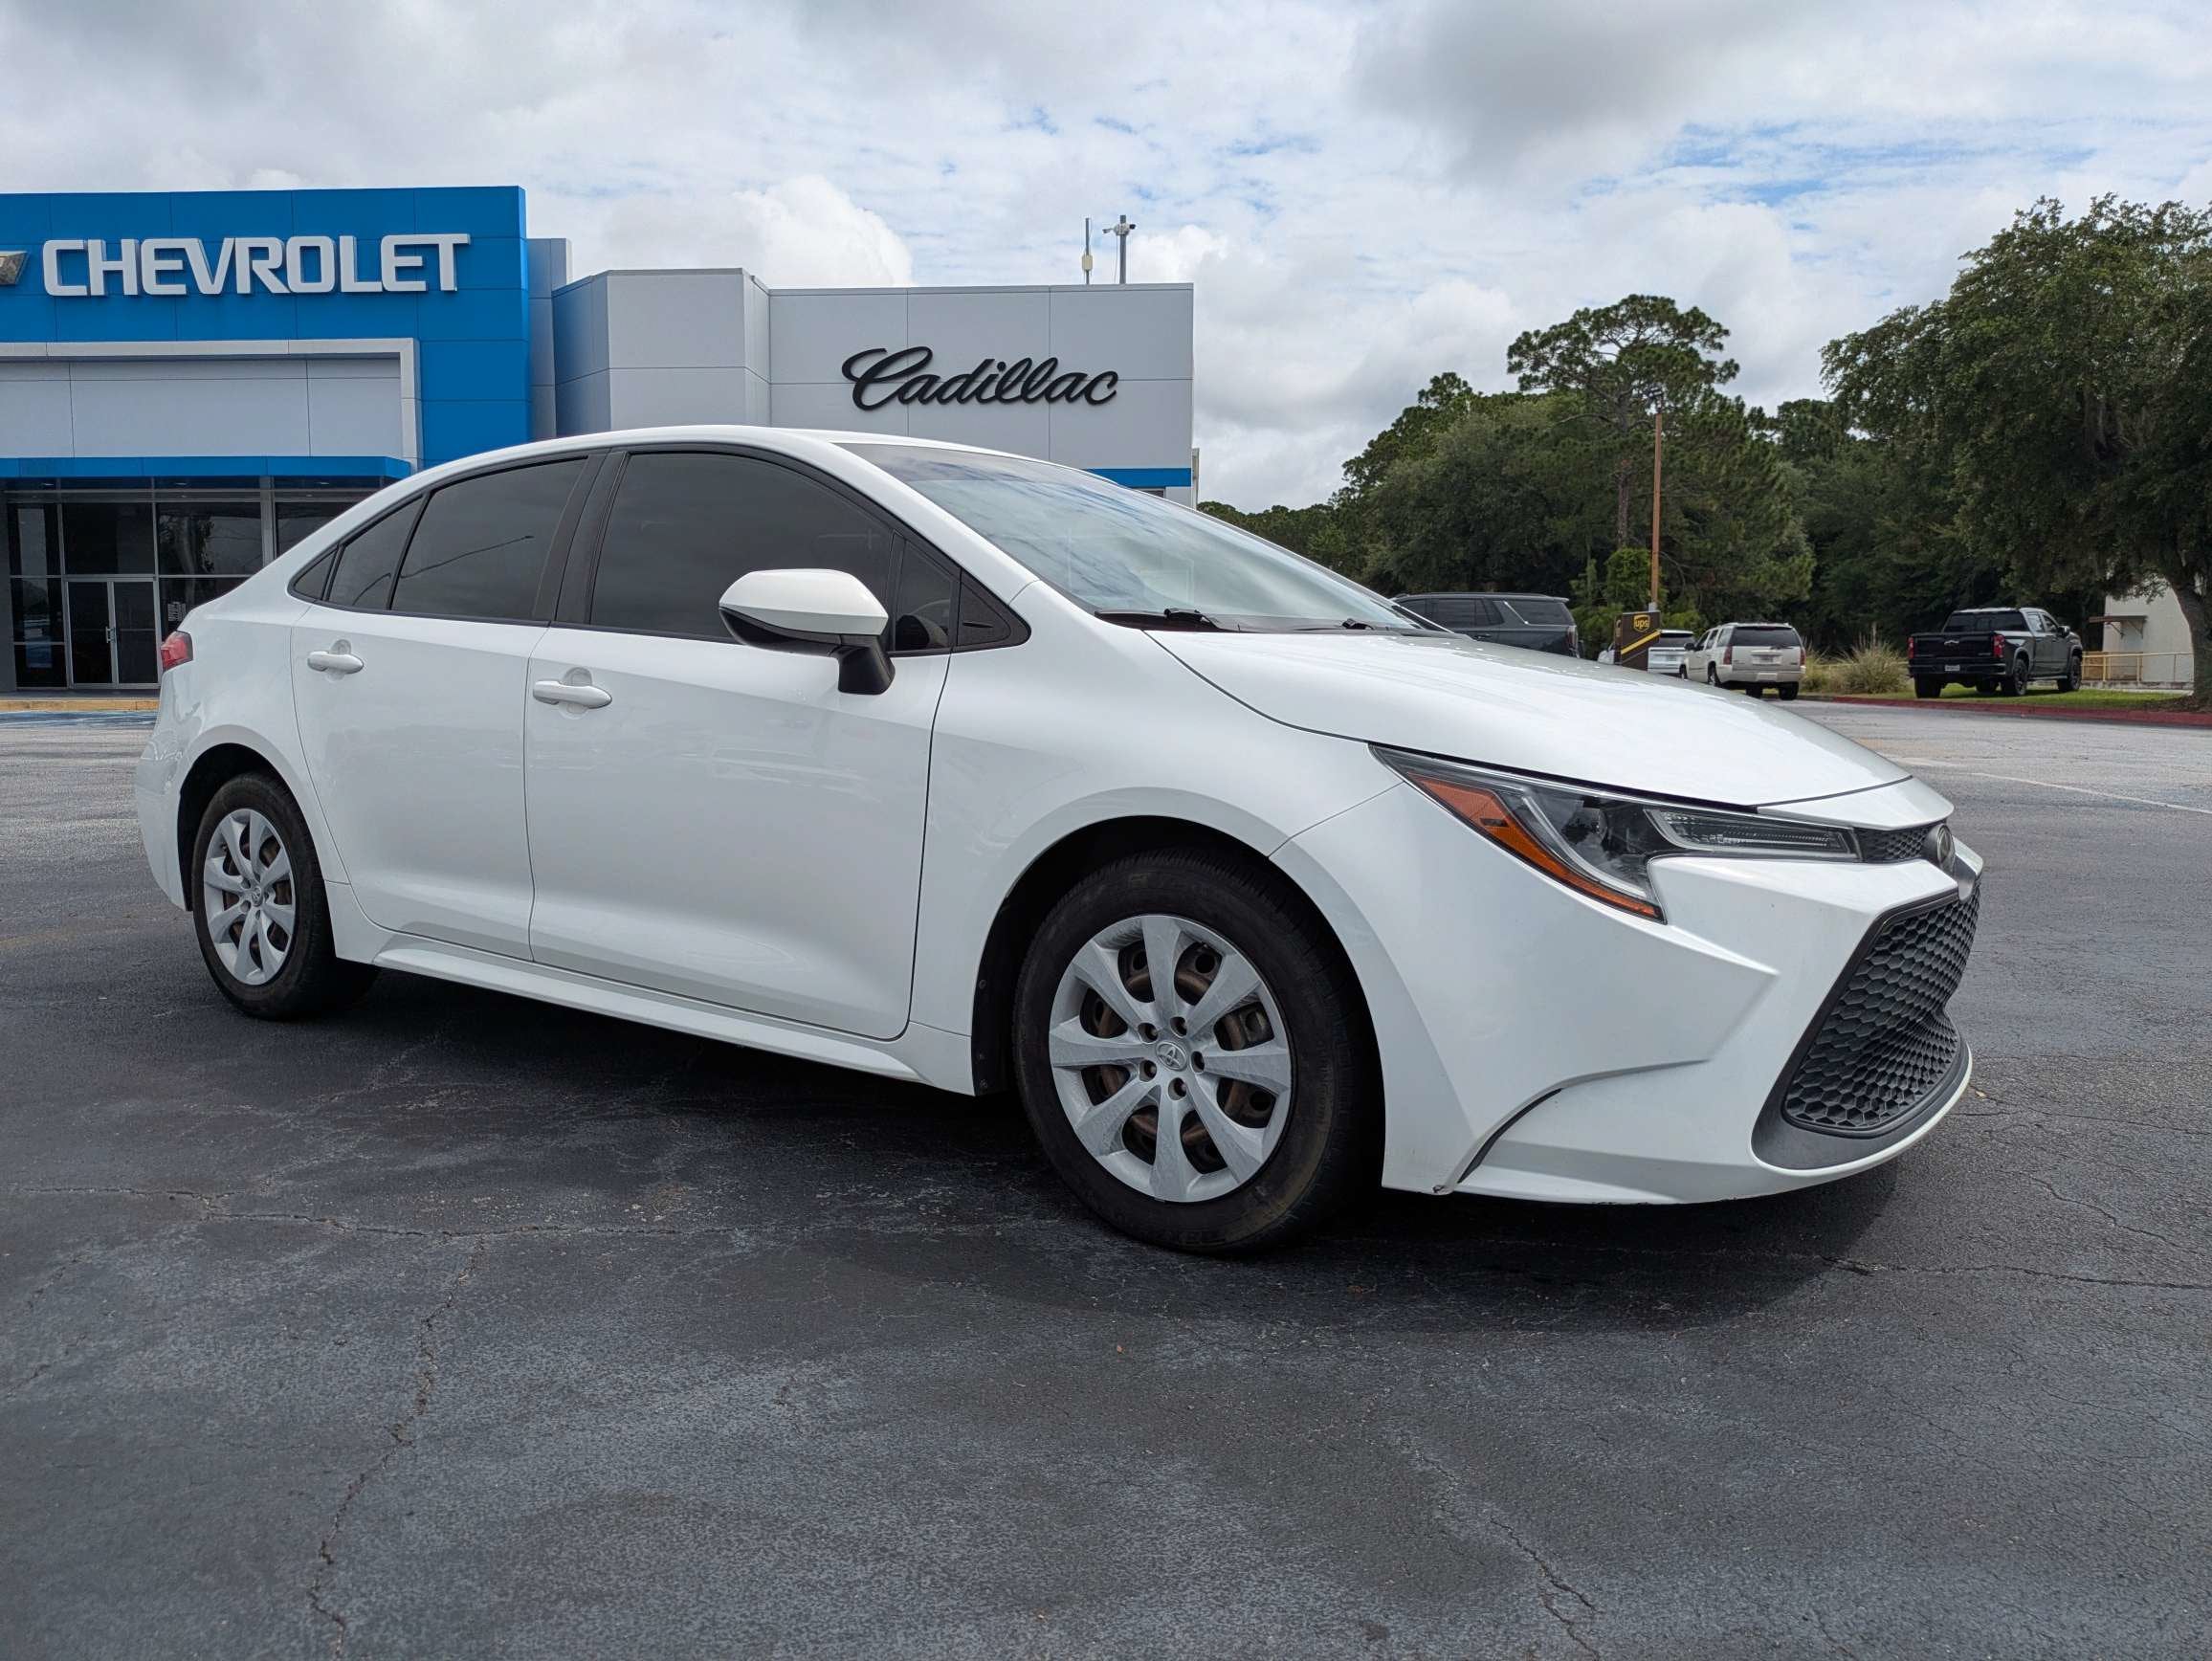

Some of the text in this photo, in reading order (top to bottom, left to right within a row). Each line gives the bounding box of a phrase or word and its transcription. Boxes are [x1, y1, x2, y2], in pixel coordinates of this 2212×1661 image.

[42, 233, 471, 297] CHEVROLET
[841, 345, 1118, 411] Cadillac
[1635, 619, 1649, 630] ups
